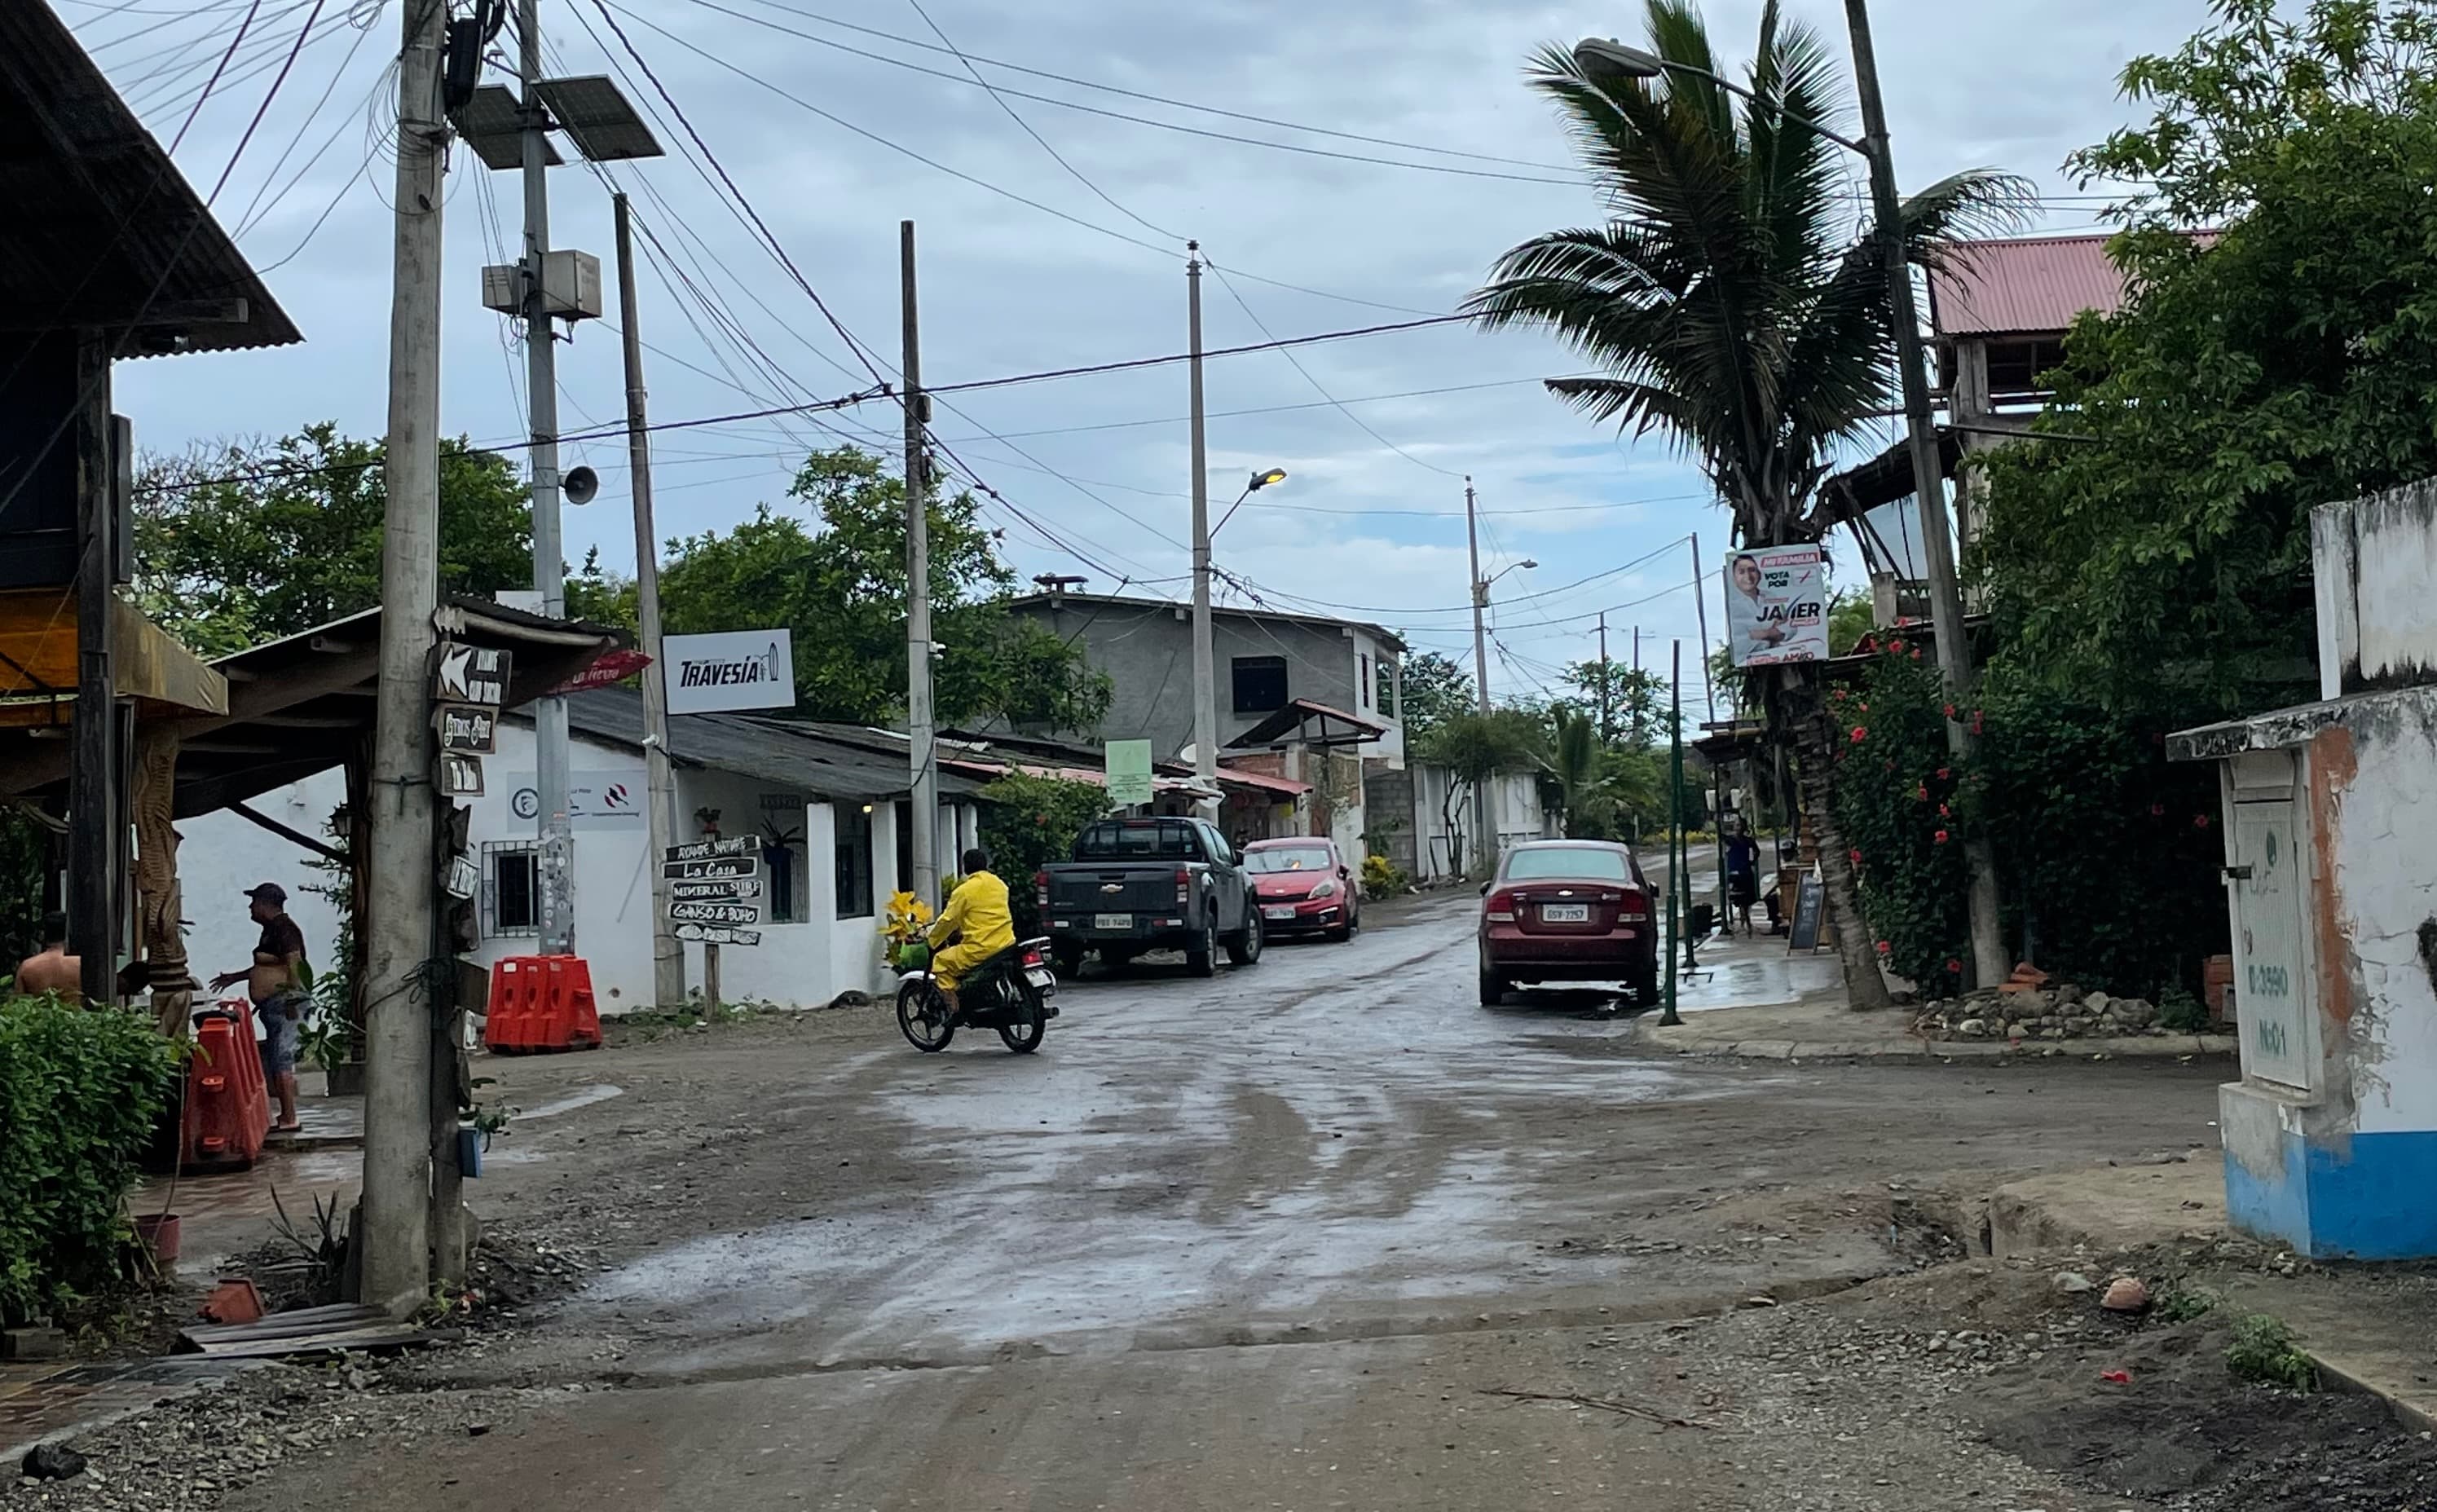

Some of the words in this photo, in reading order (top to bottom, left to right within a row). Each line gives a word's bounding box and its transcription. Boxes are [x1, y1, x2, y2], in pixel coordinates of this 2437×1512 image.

[1765, 571, 1790, 580] VOTA
[1769, 580, 1787, 588] POR
[1756, 602, 1820, 622] JAVIER
[680, 655, 758, 687] TRAVESÍA
[714, 838, 746, 854] NATURE
[684, 862, 702, 878] La
[706, 862, 737, 877] Casa
[673, 885, 728, 897] MINERAL
[730, 881, 760, 893] SURF
[672, 905, 716, 919] GANSO
